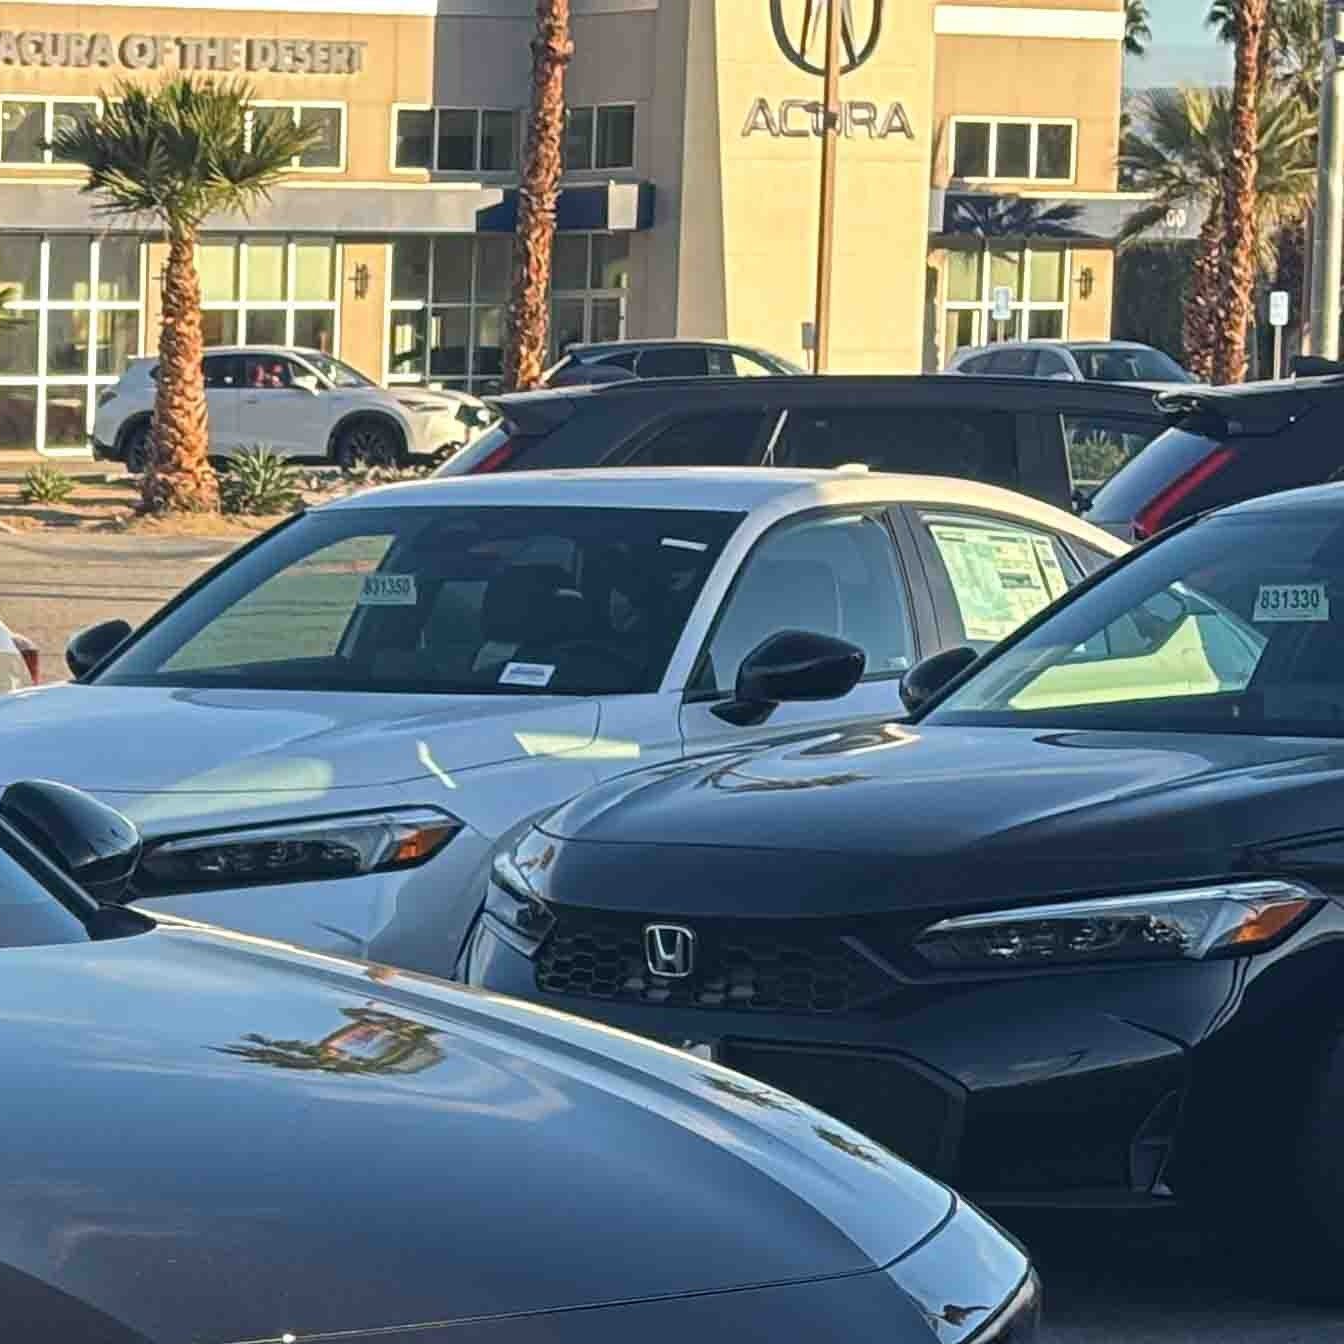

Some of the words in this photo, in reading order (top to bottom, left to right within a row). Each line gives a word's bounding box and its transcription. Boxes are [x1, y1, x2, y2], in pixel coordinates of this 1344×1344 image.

[118, 34, 175, 69] OF
[175, 36, 244, 71] THE
[245, 38, 367, 74] DESERT
[740, 97, 914, 140] ACURA
[1259, 589, 1320, 609] 831330
